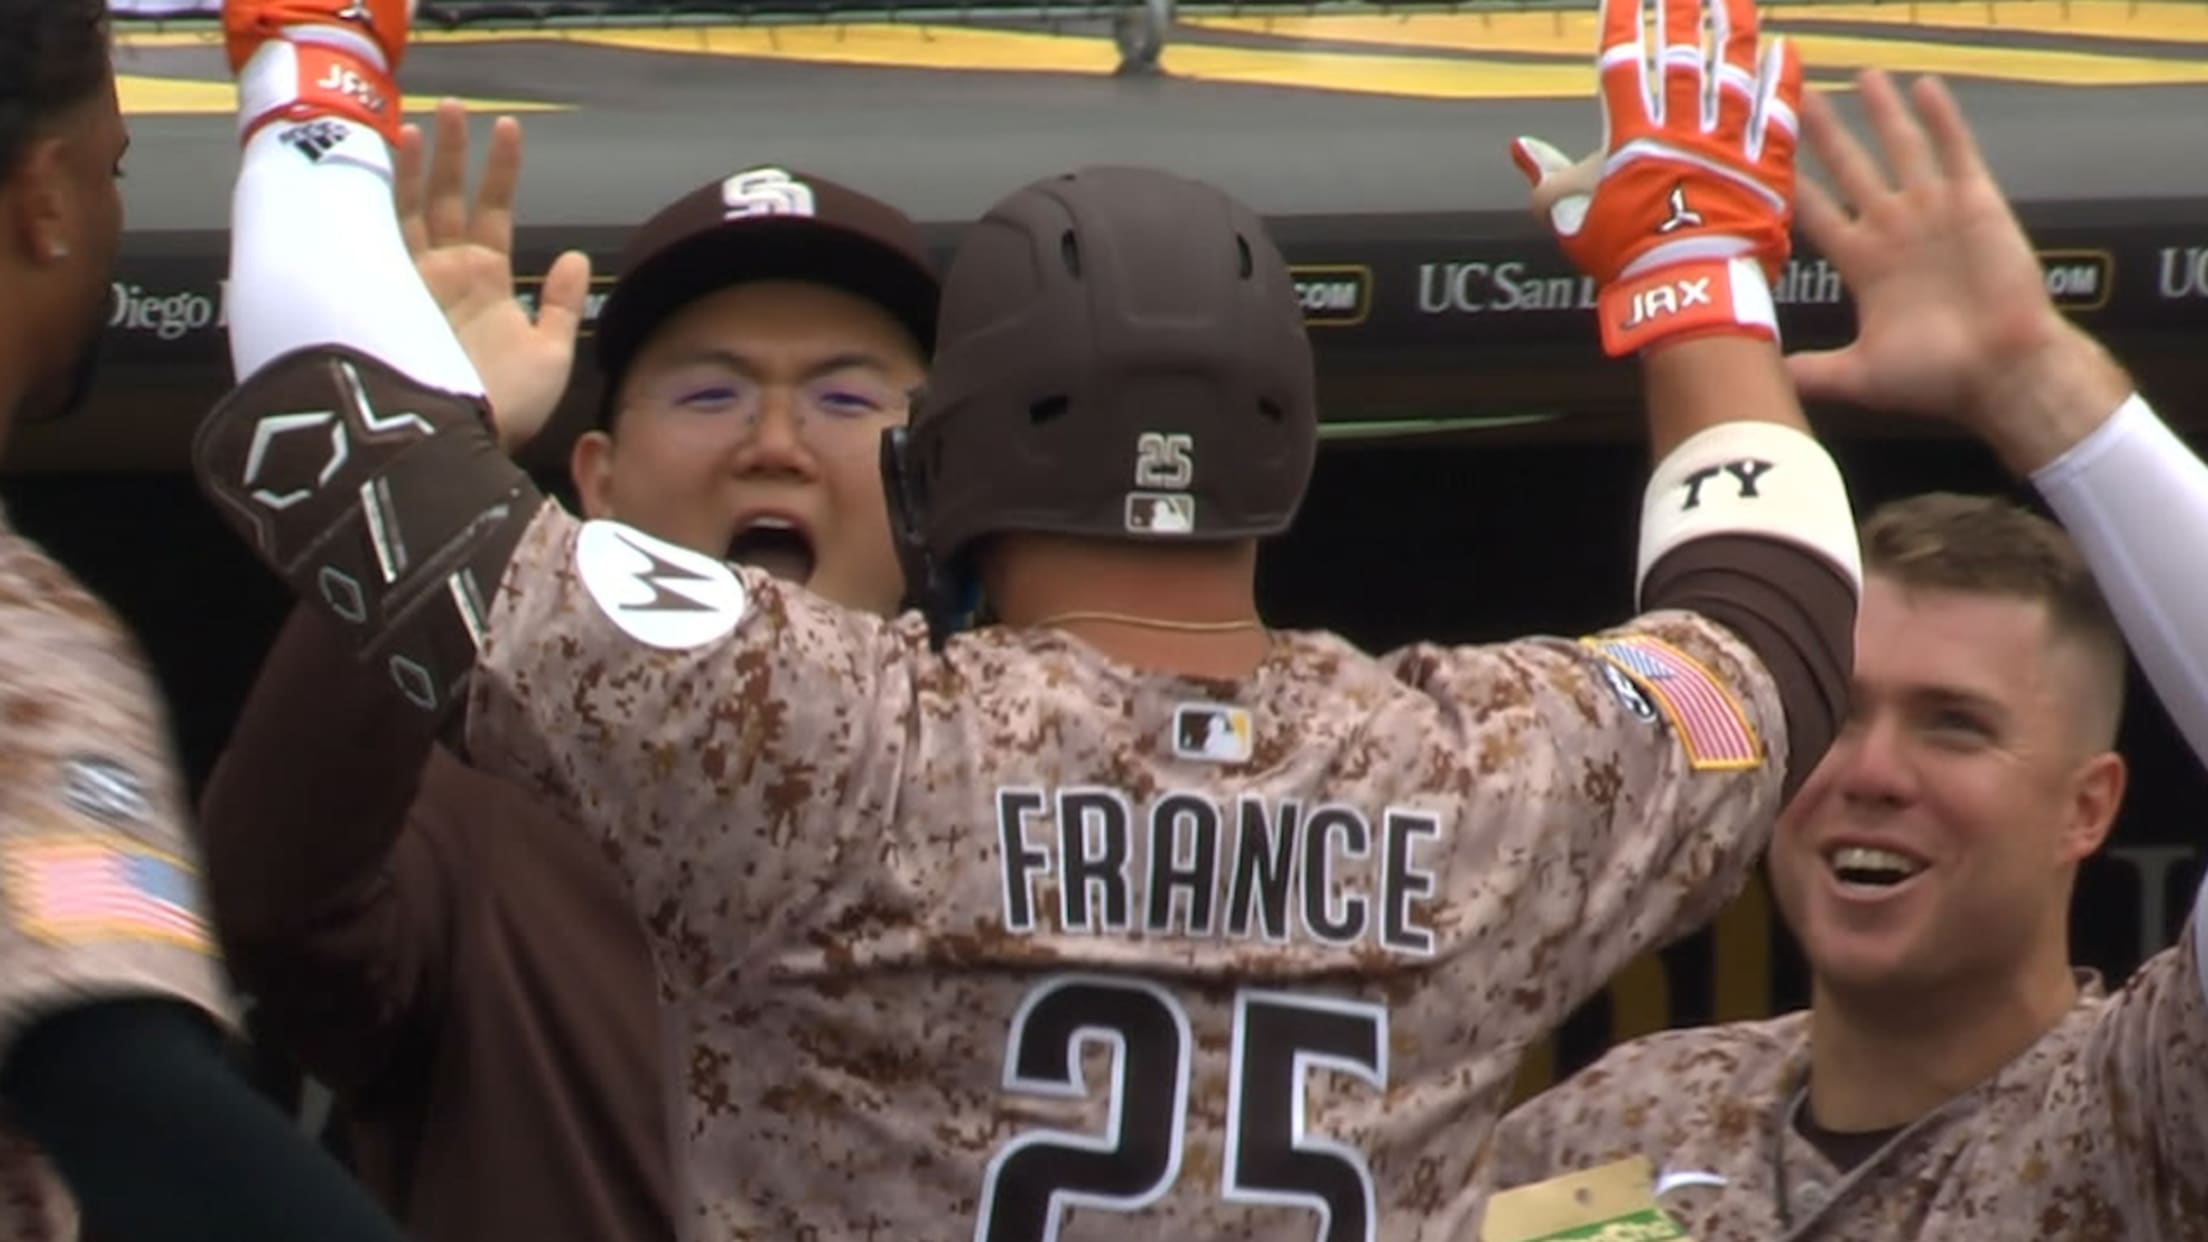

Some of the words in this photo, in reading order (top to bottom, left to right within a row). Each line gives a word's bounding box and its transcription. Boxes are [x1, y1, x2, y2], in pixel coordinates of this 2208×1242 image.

[1418, 263, 1488, 312] UC
[1491, 262, 1572, 311] San
[1621, 276, 1712, 331] JAX
[1135, 431, 1195, 489] 25
[1682, 459, 1775, 511] TY
[997, 787, 1439, 956] FRANCE
[974, 977, 1390, 1242] 25
